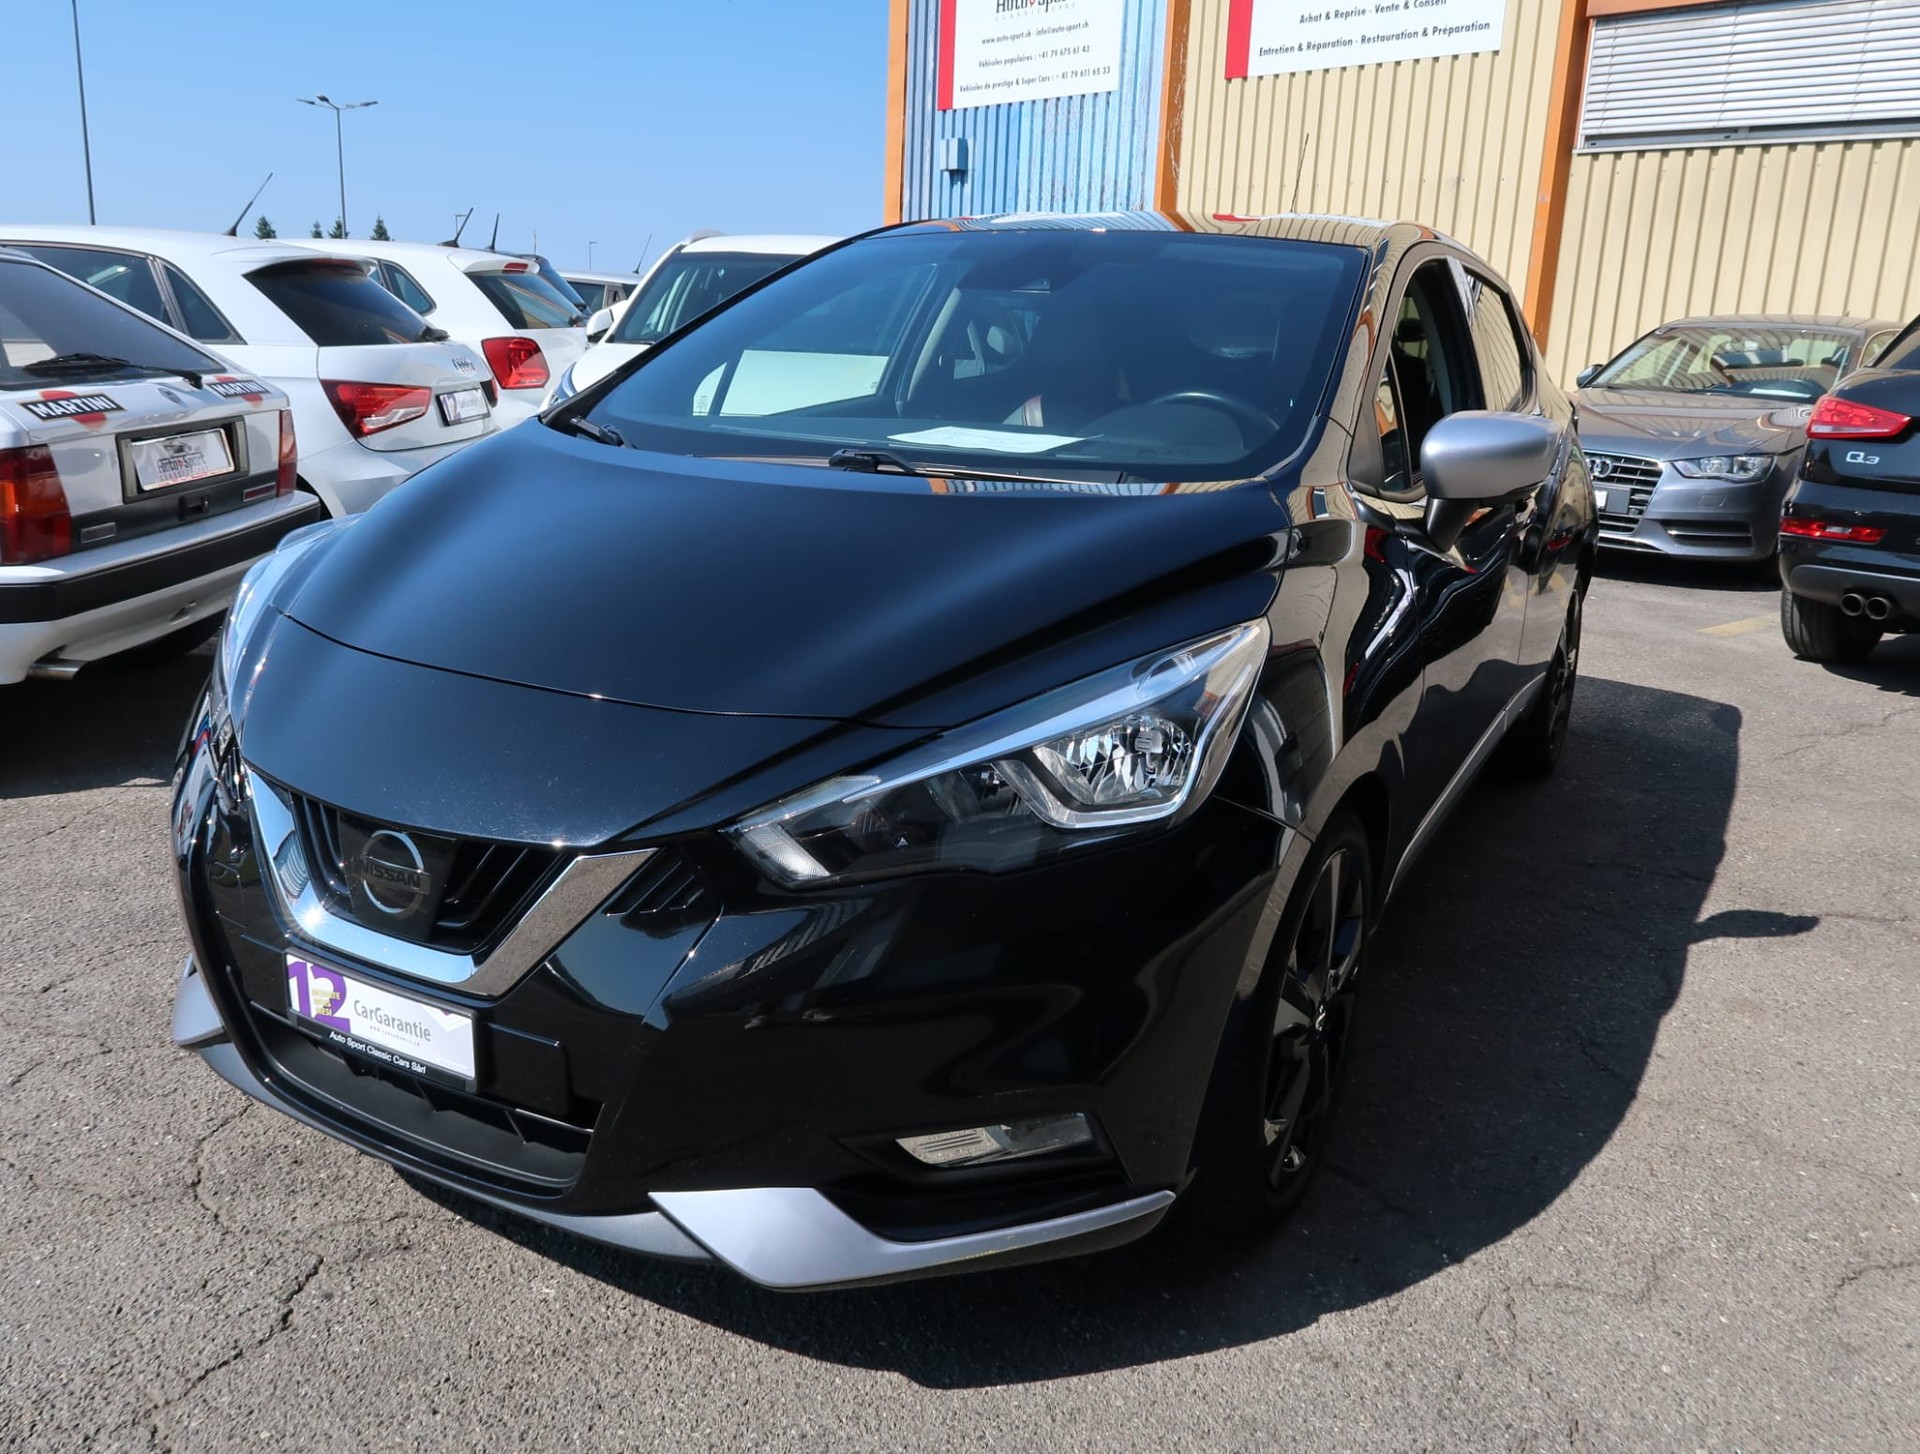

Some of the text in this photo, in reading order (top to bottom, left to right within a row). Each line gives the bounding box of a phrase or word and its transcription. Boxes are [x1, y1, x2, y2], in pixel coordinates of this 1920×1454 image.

[1299, 13, 1322, 24] Achat
[1325, 11, 1331, 21] &
[1334, 6, 1366, 20] Reprise
[1375, 3, 1400, 14] Vente
[1403, 0, 1410, 10] &
[1259, 43, 1295, 57] Entretien
[1297, 43, 1304, 52] &
[1361, 29, 1419, 45] Restauration
[1422, 27, 1429, 37] &
[1432, 20, 1491, 37] Préparation
[1004, 53, 1033, 66] populaires
[984, 81, 990, 90] de
[992, 79, 1014, 91] prestige
[1021, 75, 1037, 86] Super
[1038, 73, 1051, 83] Cars
[212, 381, 267, 397] MARTINI
[28, 395, 117, 418] MARTINI
[1845, 451, 1880, 465] Q3
[361, 863, 419, 888] NISSAN
[288, 961, 351, 1033] 12
[353, 999, 432, 1042] CarGarantie
[329, 1031, 347, 1044] Auto
[347, 1037, 366, 1052] Sport
[366, 1045, 392, 1061] Classic
[393, 1054, 411, 1069] Cars
